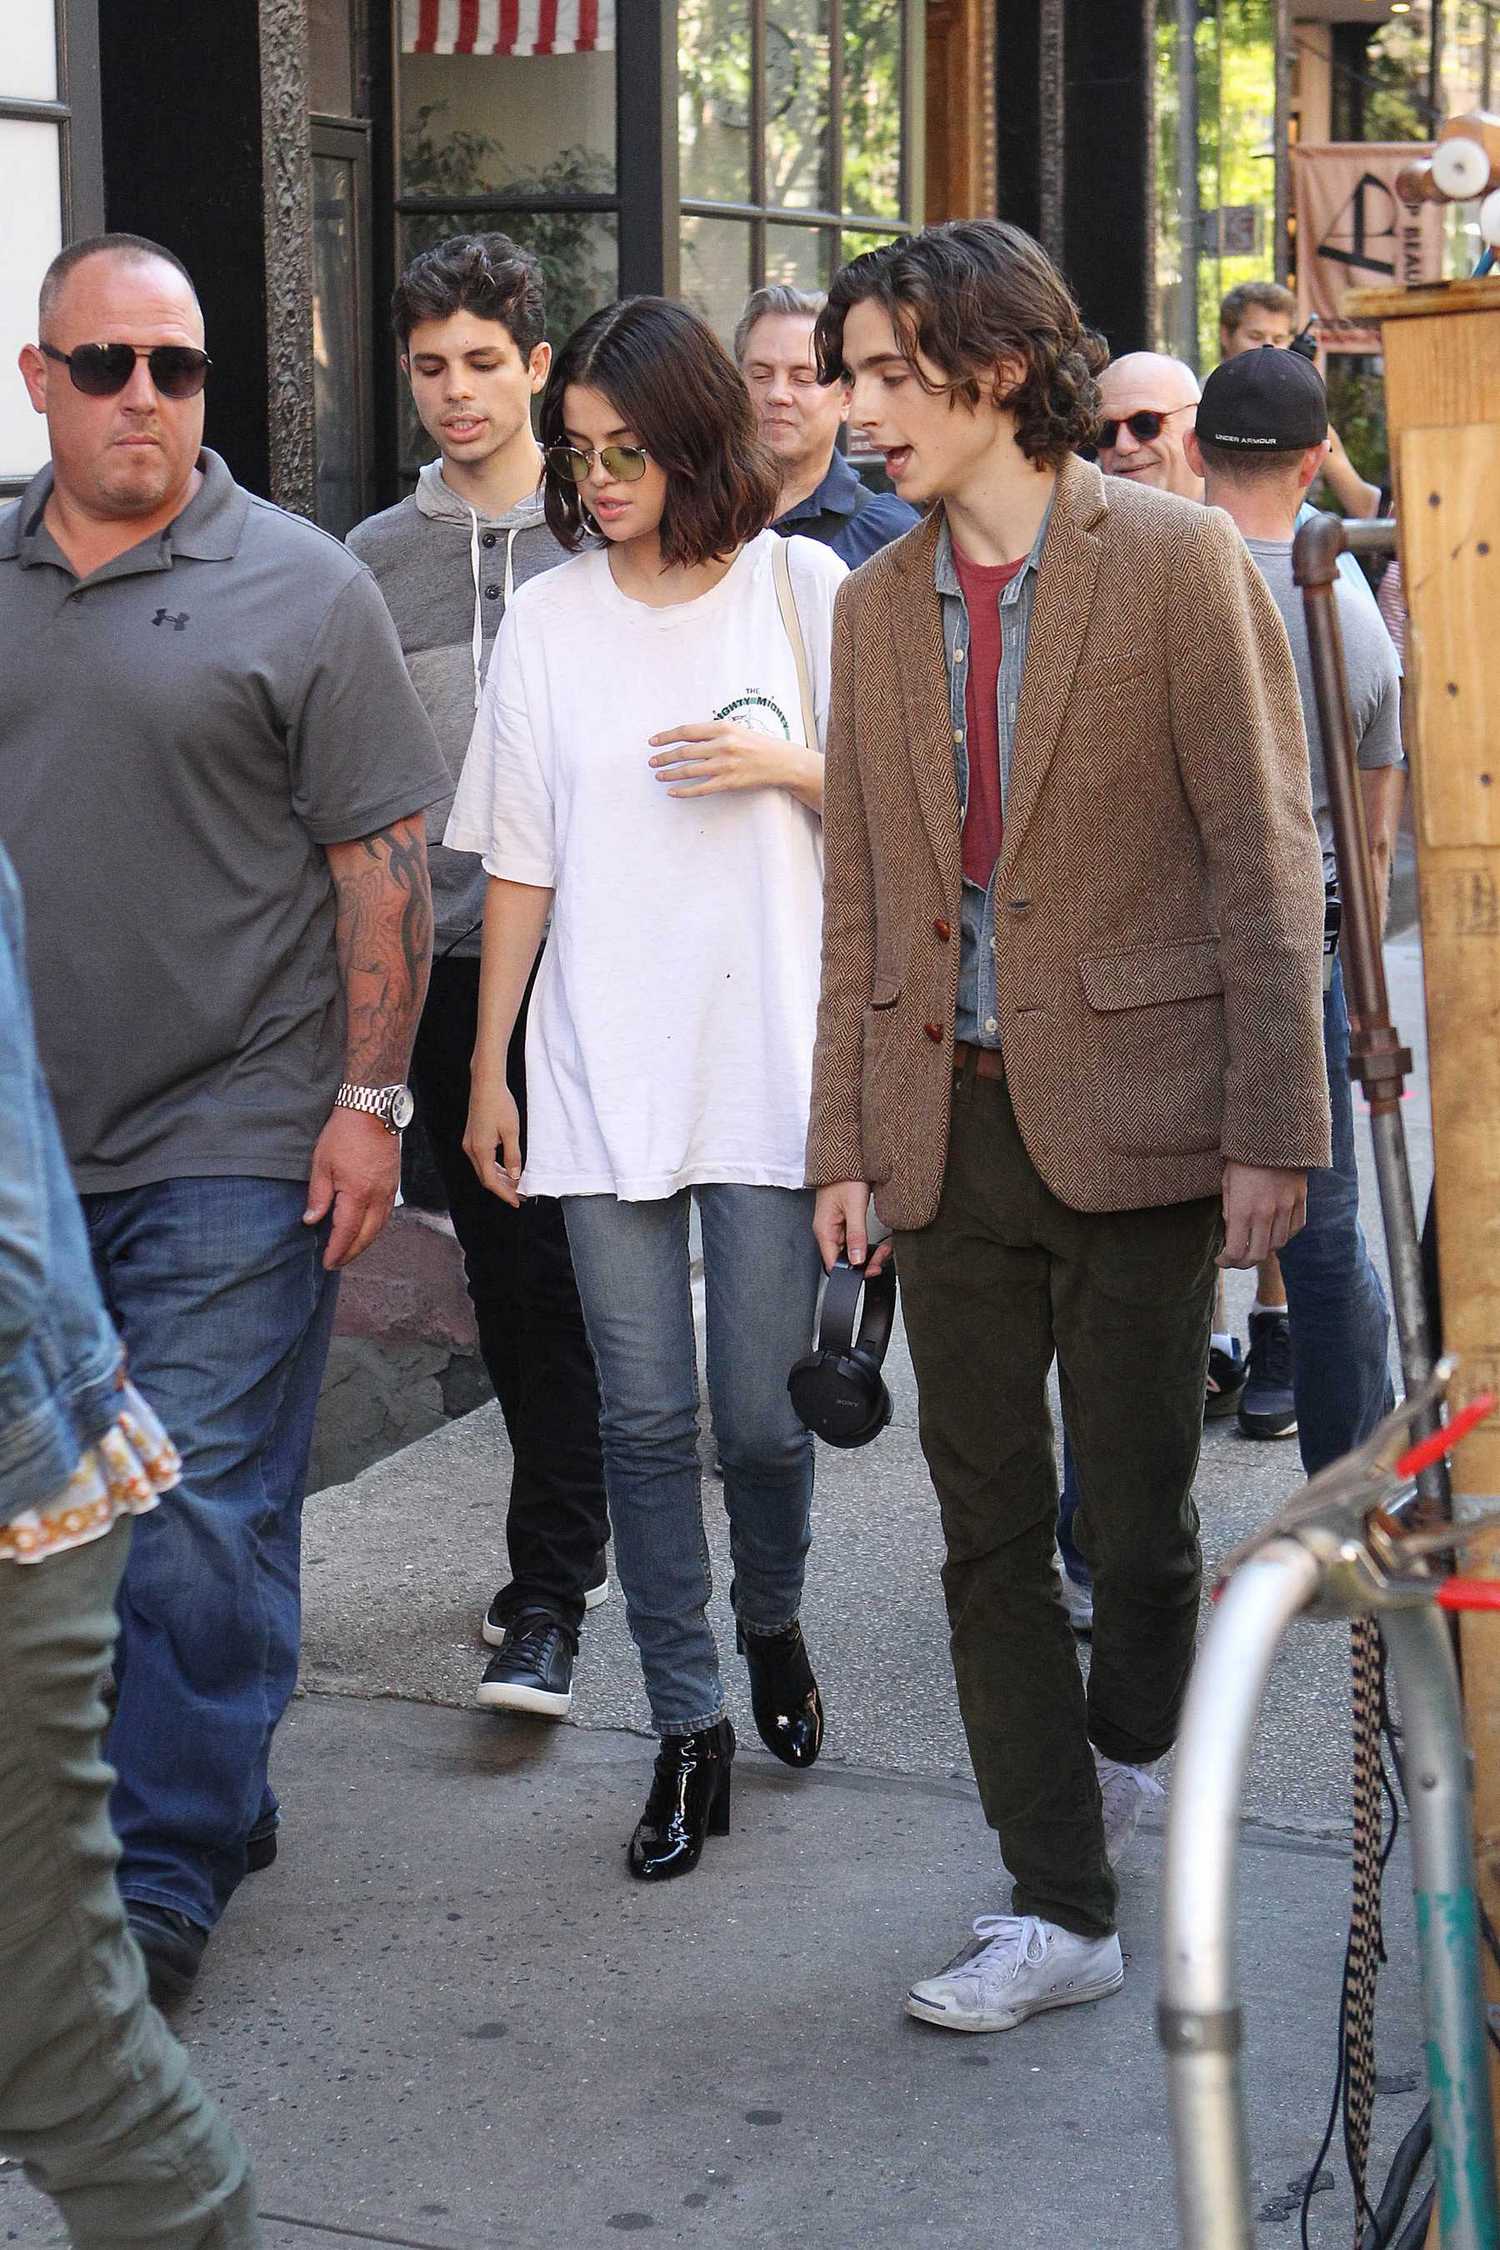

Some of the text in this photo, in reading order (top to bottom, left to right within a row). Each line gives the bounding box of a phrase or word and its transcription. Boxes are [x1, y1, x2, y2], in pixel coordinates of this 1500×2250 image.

[1404, 226, 1421, 284] BEAU
[1215, 433, 1277, 445] UNDER ARMOUR
[745, 687, 761, 695] THE
[713, 696, 751, 721] IGHTY
